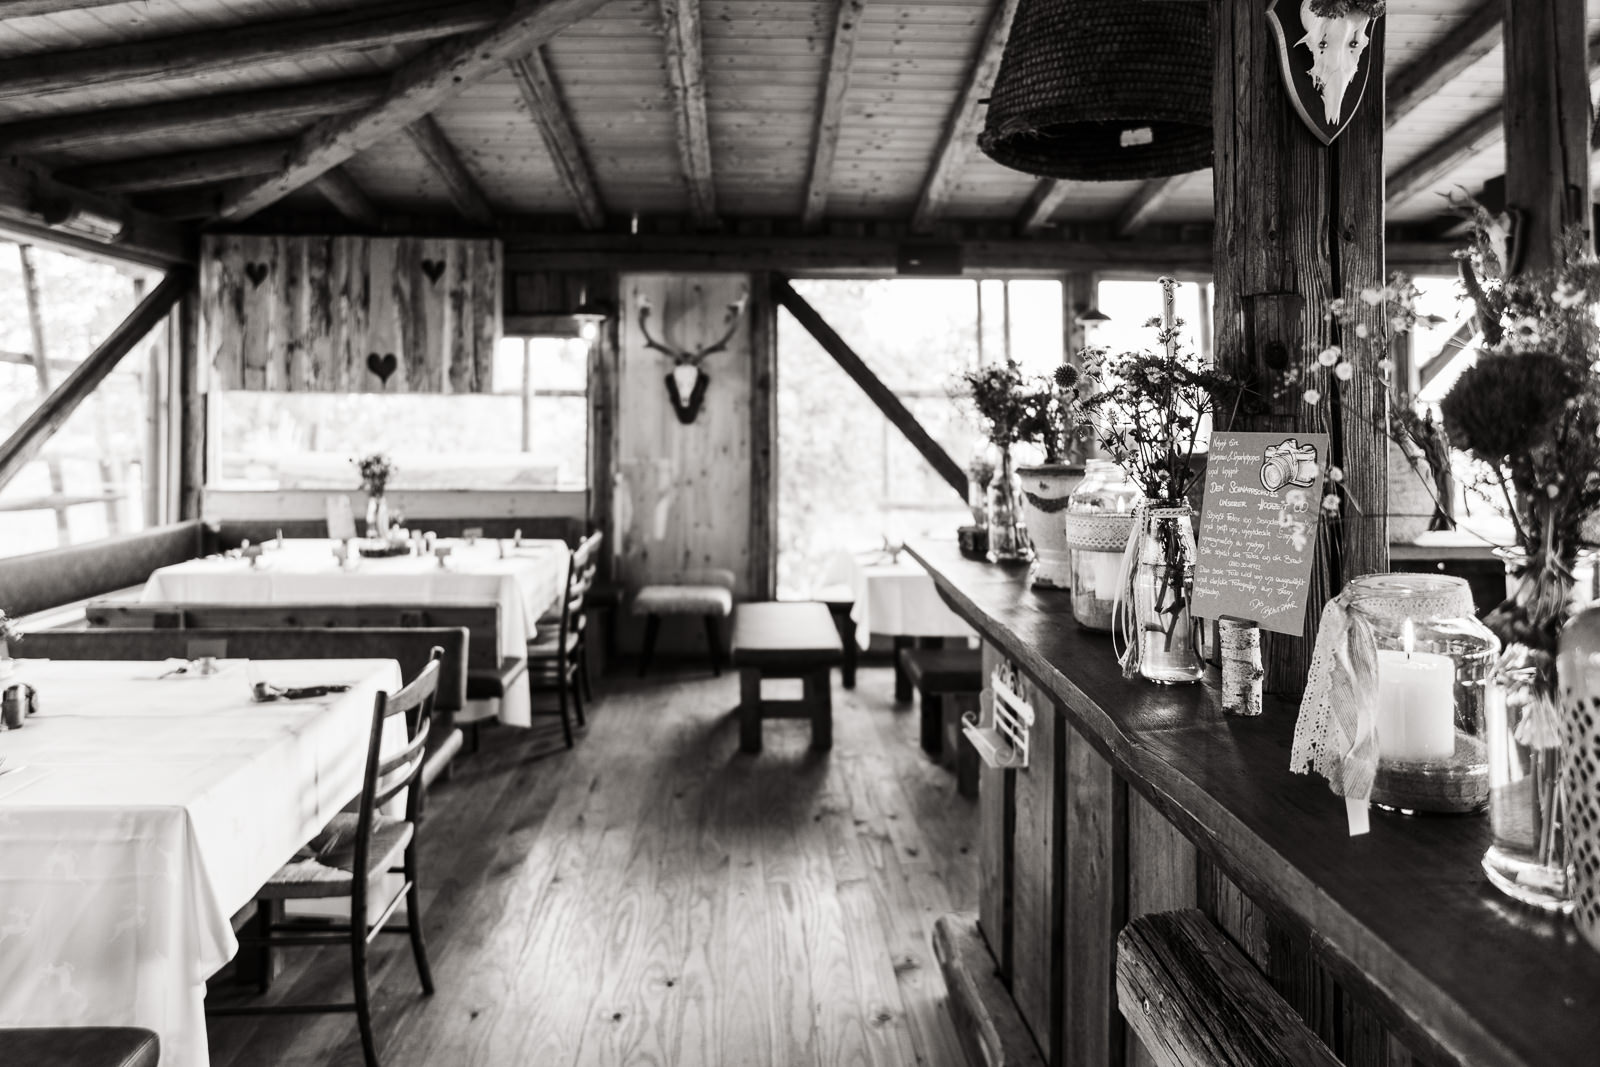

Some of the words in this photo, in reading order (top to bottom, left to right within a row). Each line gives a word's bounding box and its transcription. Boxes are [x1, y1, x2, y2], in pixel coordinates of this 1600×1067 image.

[1208, 467, 1218, 477] und
[1219, 499, 1247, 507] UNSERER
[1226, 512, 1241, 523] Fotos
[1242, 517, 1252, 529] von
[1203, 523, 1214, 533] und
[1246, 542, 1265, 553] machen
[1199, 546, 1212, 555] Bitte
[1243, 551, 1260, 560] Fotos
[1261, 555, 1271, 564] an
[1272, 553, 1283, 561] die
[1284, 554, 1304, 565] Braut
[1196, 576, 1208, 586] und
[1226, 569, 1240, 577] Foto
[1254, 574, 1264, 585] von
[1264, 576, 1275, 586] uns
